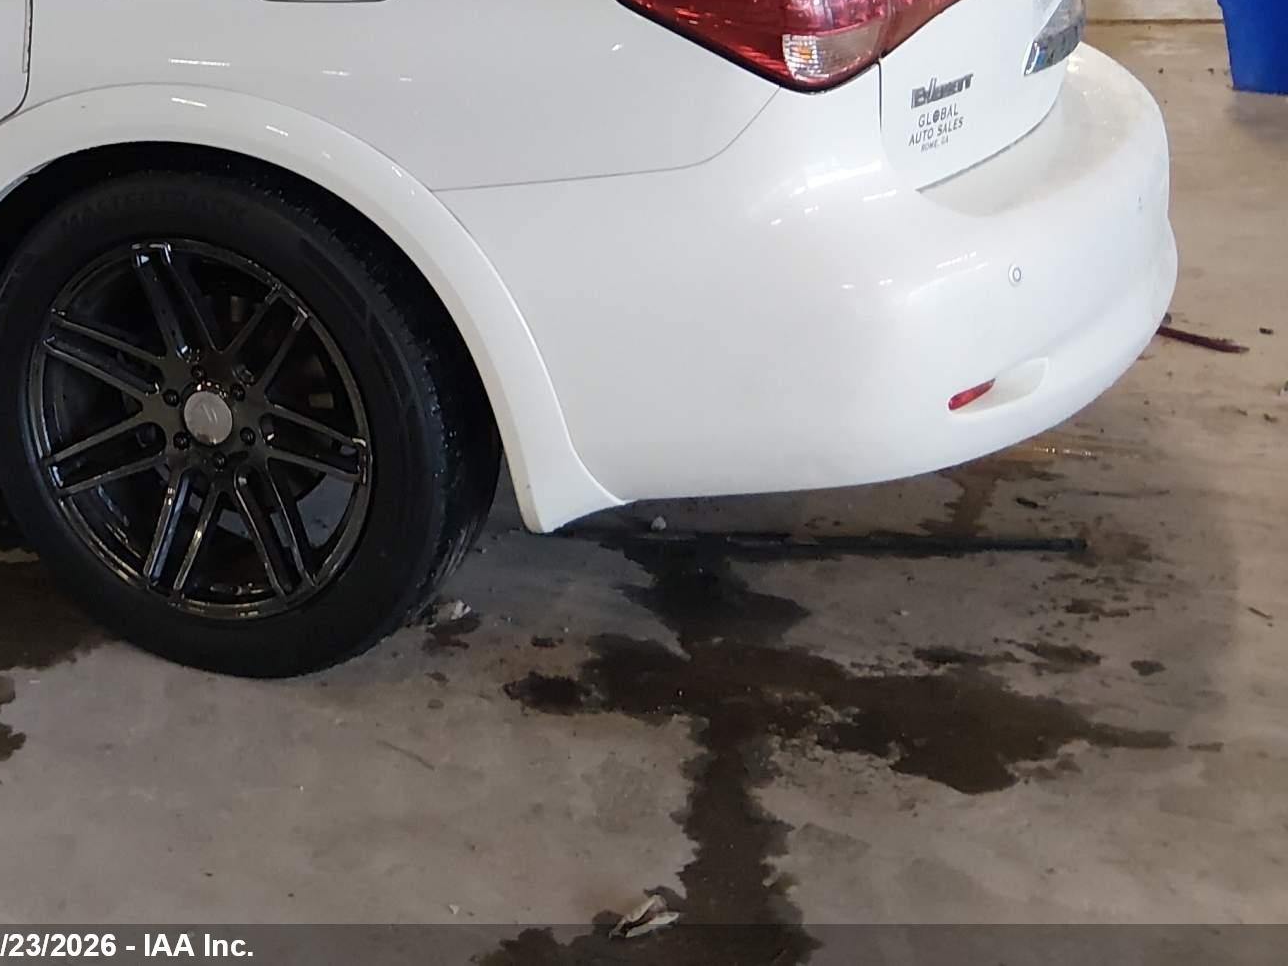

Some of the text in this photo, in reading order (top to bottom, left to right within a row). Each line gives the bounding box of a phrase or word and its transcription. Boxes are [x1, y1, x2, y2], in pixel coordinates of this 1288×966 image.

[918, 103, 959, 127] GLOBAL
[908, 117, 964, 146] AUTO SALES
